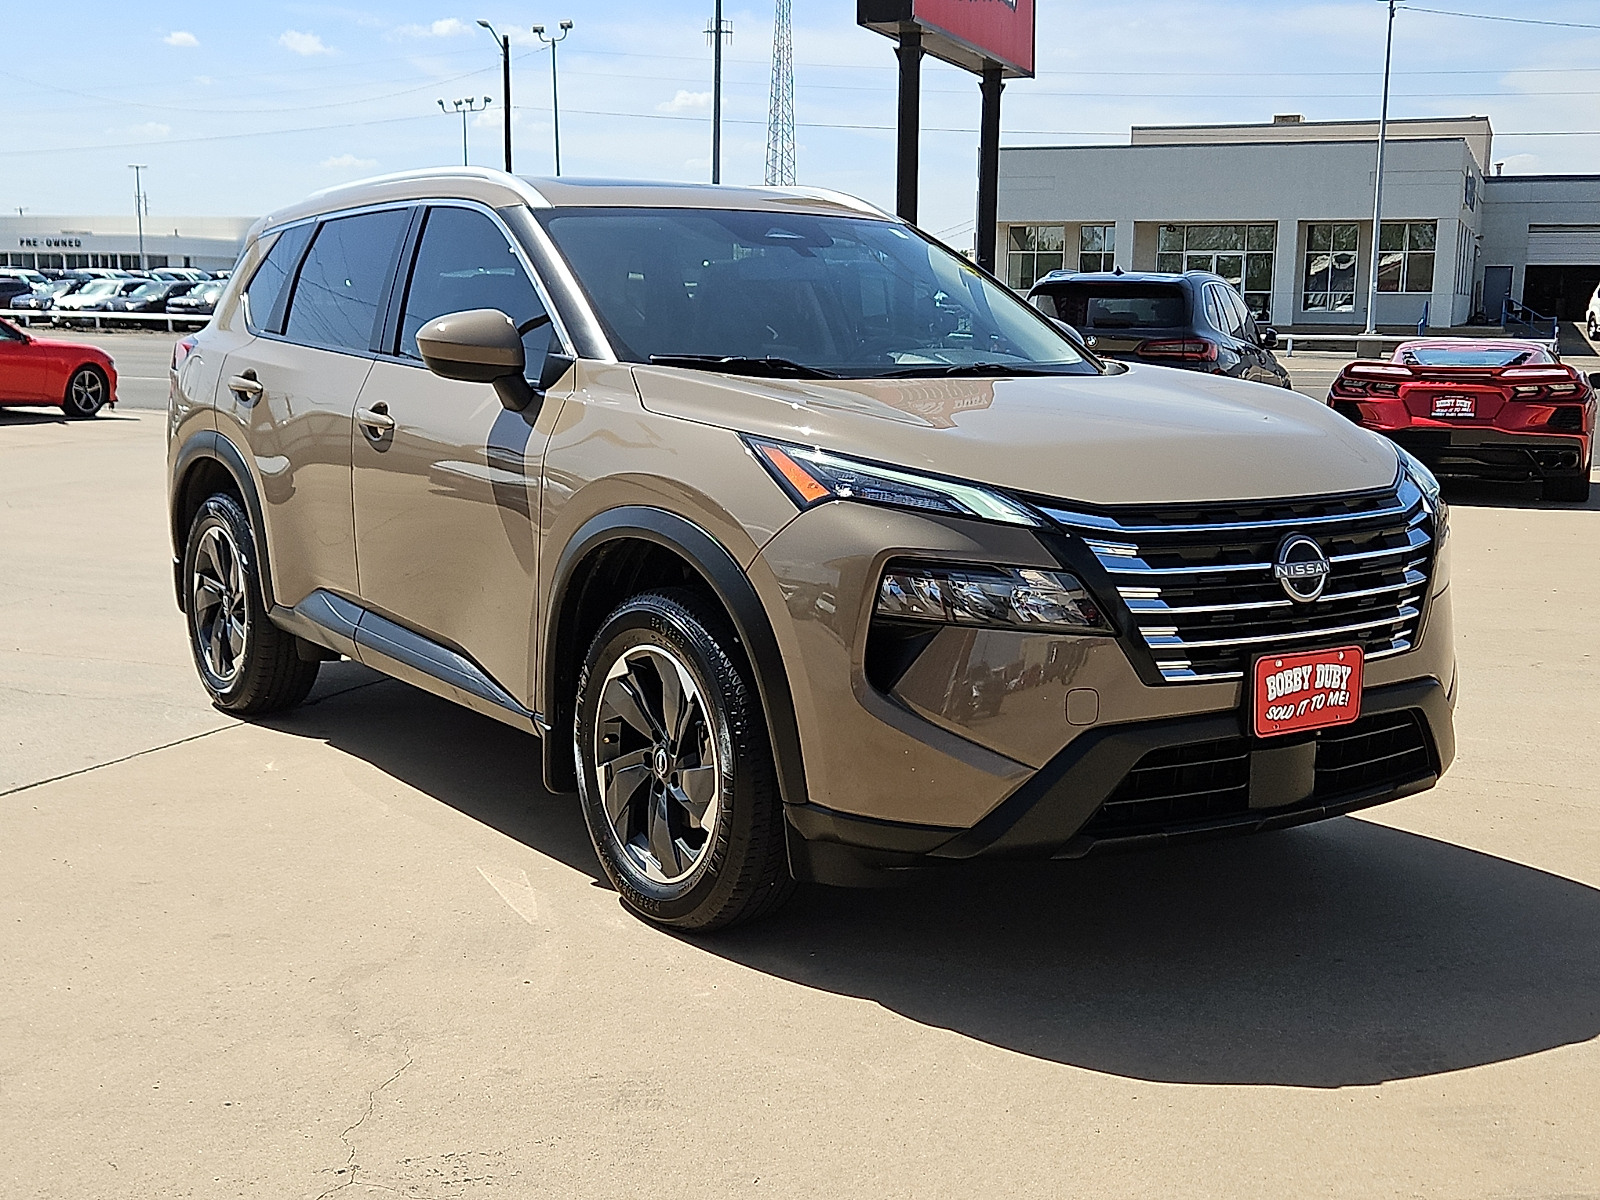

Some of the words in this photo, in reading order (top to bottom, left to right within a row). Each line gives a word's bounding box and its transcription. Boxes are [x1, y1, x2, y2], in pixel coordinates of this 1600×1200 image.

[1277, 562, 1329, 575] NISSAN
[1266, 664, 1312, 702] BOBBY
[1315, 663, 1352, 690] DUBY
[1265, 705, 1295, 720] SOLD
[1296, 699, 1310, 717] IT
[1310, 693, 1326, 712] TO
[1326, 690, 1350, 707] ME!
